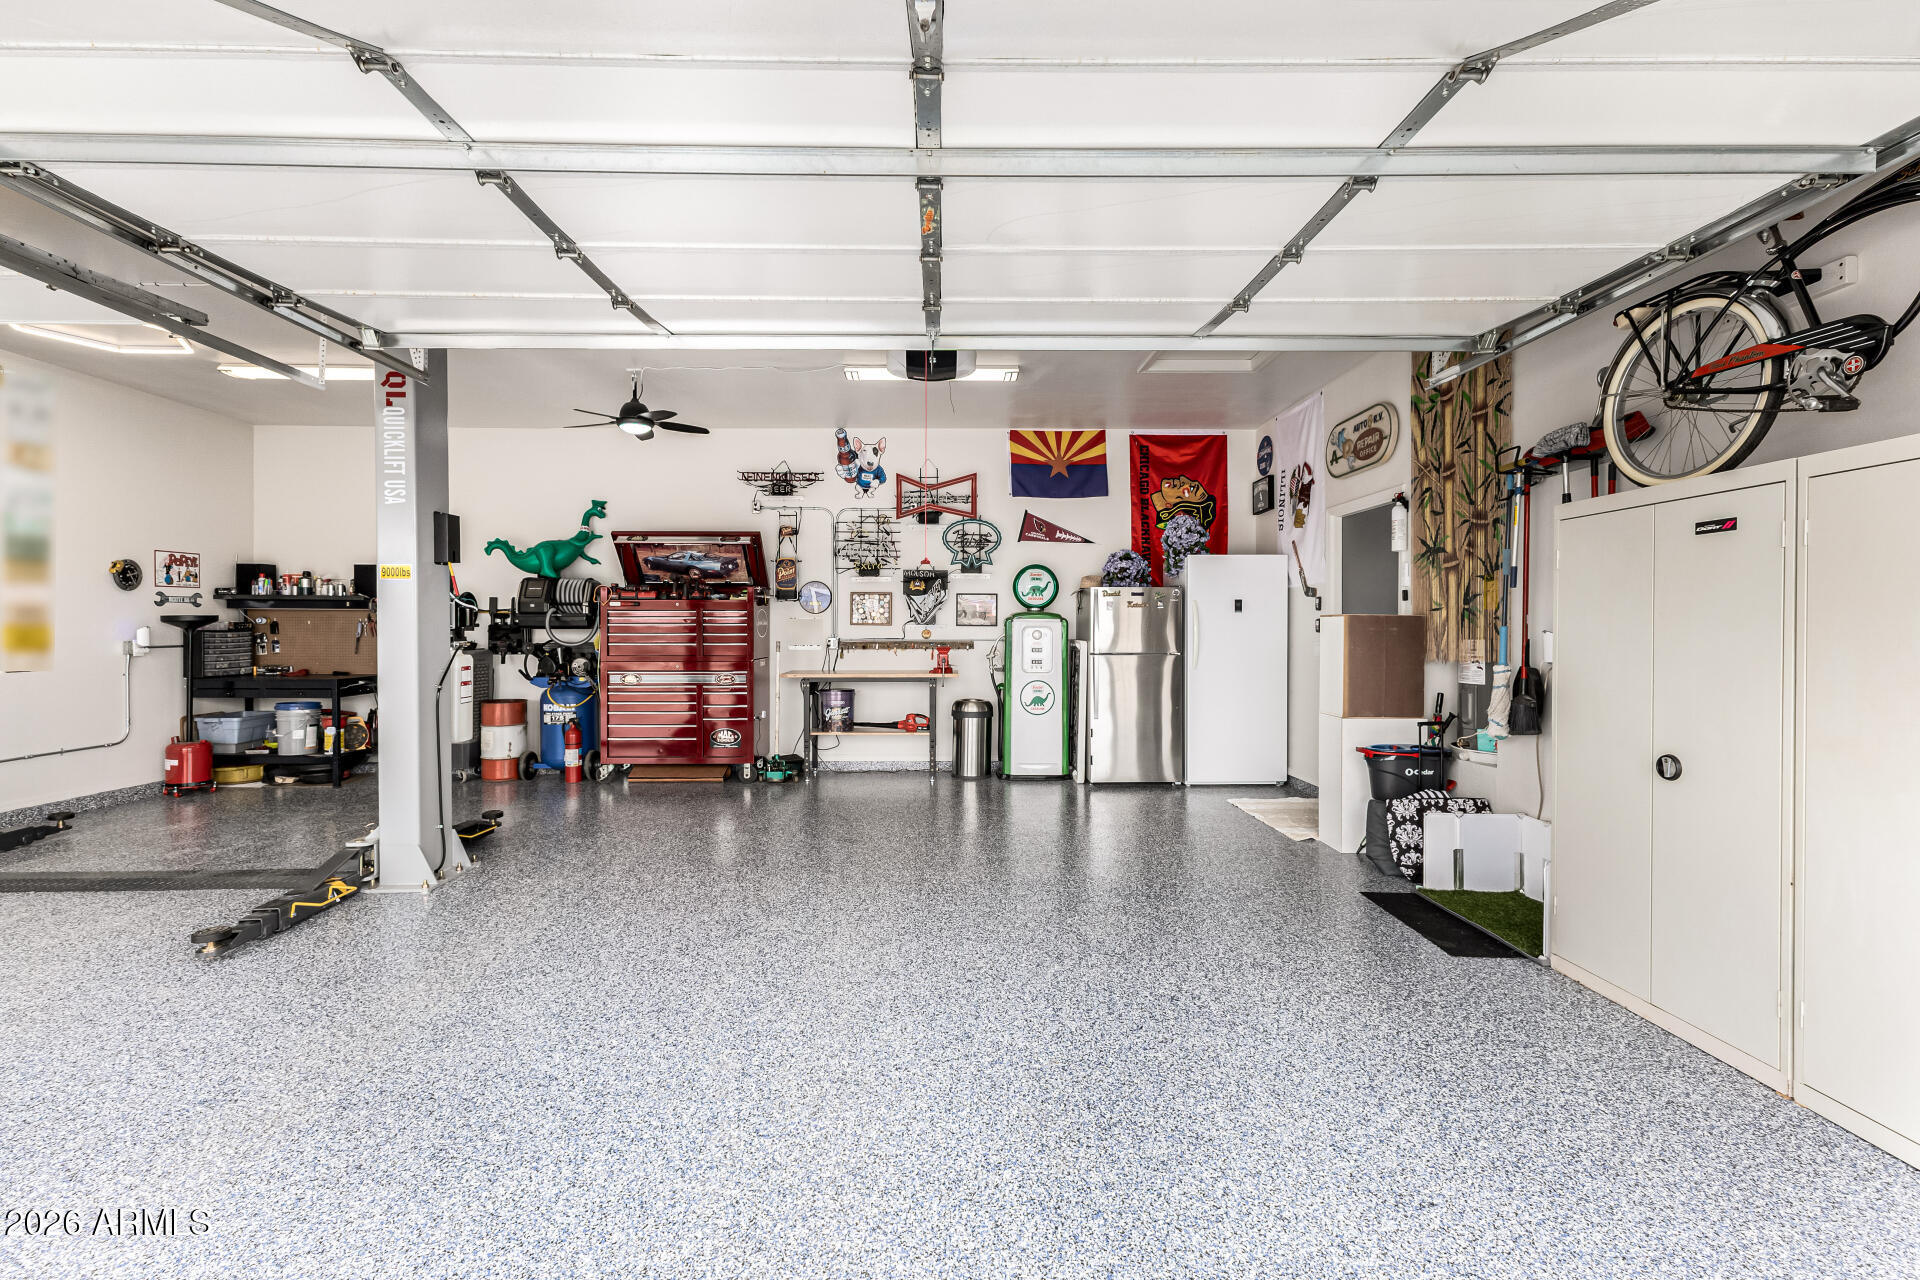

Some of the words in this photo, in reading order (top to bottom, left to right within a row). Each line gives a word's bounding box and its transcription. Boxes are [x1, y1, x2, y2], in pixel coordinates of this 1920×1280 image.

[1353, 420, 1368, 434] AUTO
[382, 407, 406, 475] QUICKLIFT
[1356, 431, 1380, 451] REPAIR
[1359, 445, 1377, 457] OFFICE
[1139, 445, 1150, 494] CHICAGO
[384, 480, 406, 505] USA
[1278, 469, 1286, 531] ILLINOIS
[381, 566, 411, 578] 9000lbs
[903, 570, 935, 578] MOLSON
